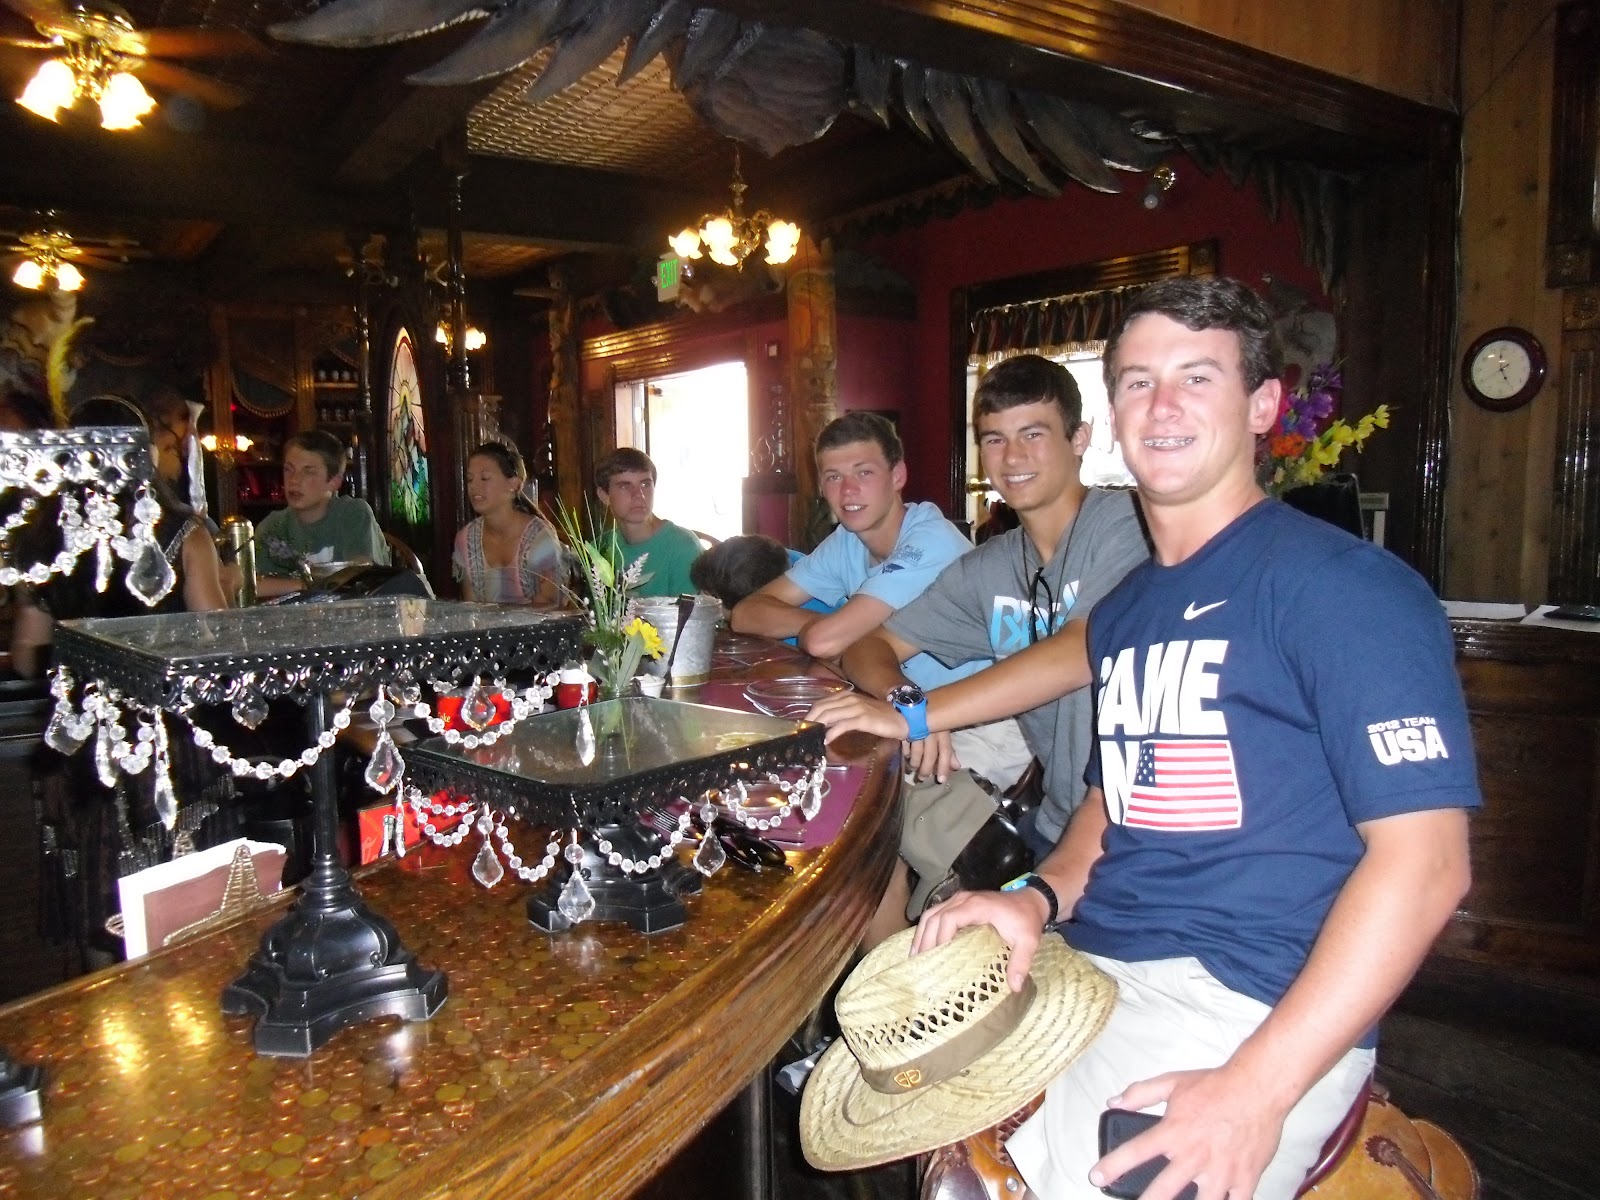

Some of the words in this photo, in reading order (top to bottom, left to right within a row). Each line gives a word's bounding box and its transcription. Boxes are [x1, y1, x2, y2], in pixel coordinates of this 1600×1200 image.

[661, 259, 679, 288] EXIT
[1367, 720, 1400, 734] 2012
[1401, 716, 1436, 728] TEAM
[1369, 725, 1449, 766] USA
